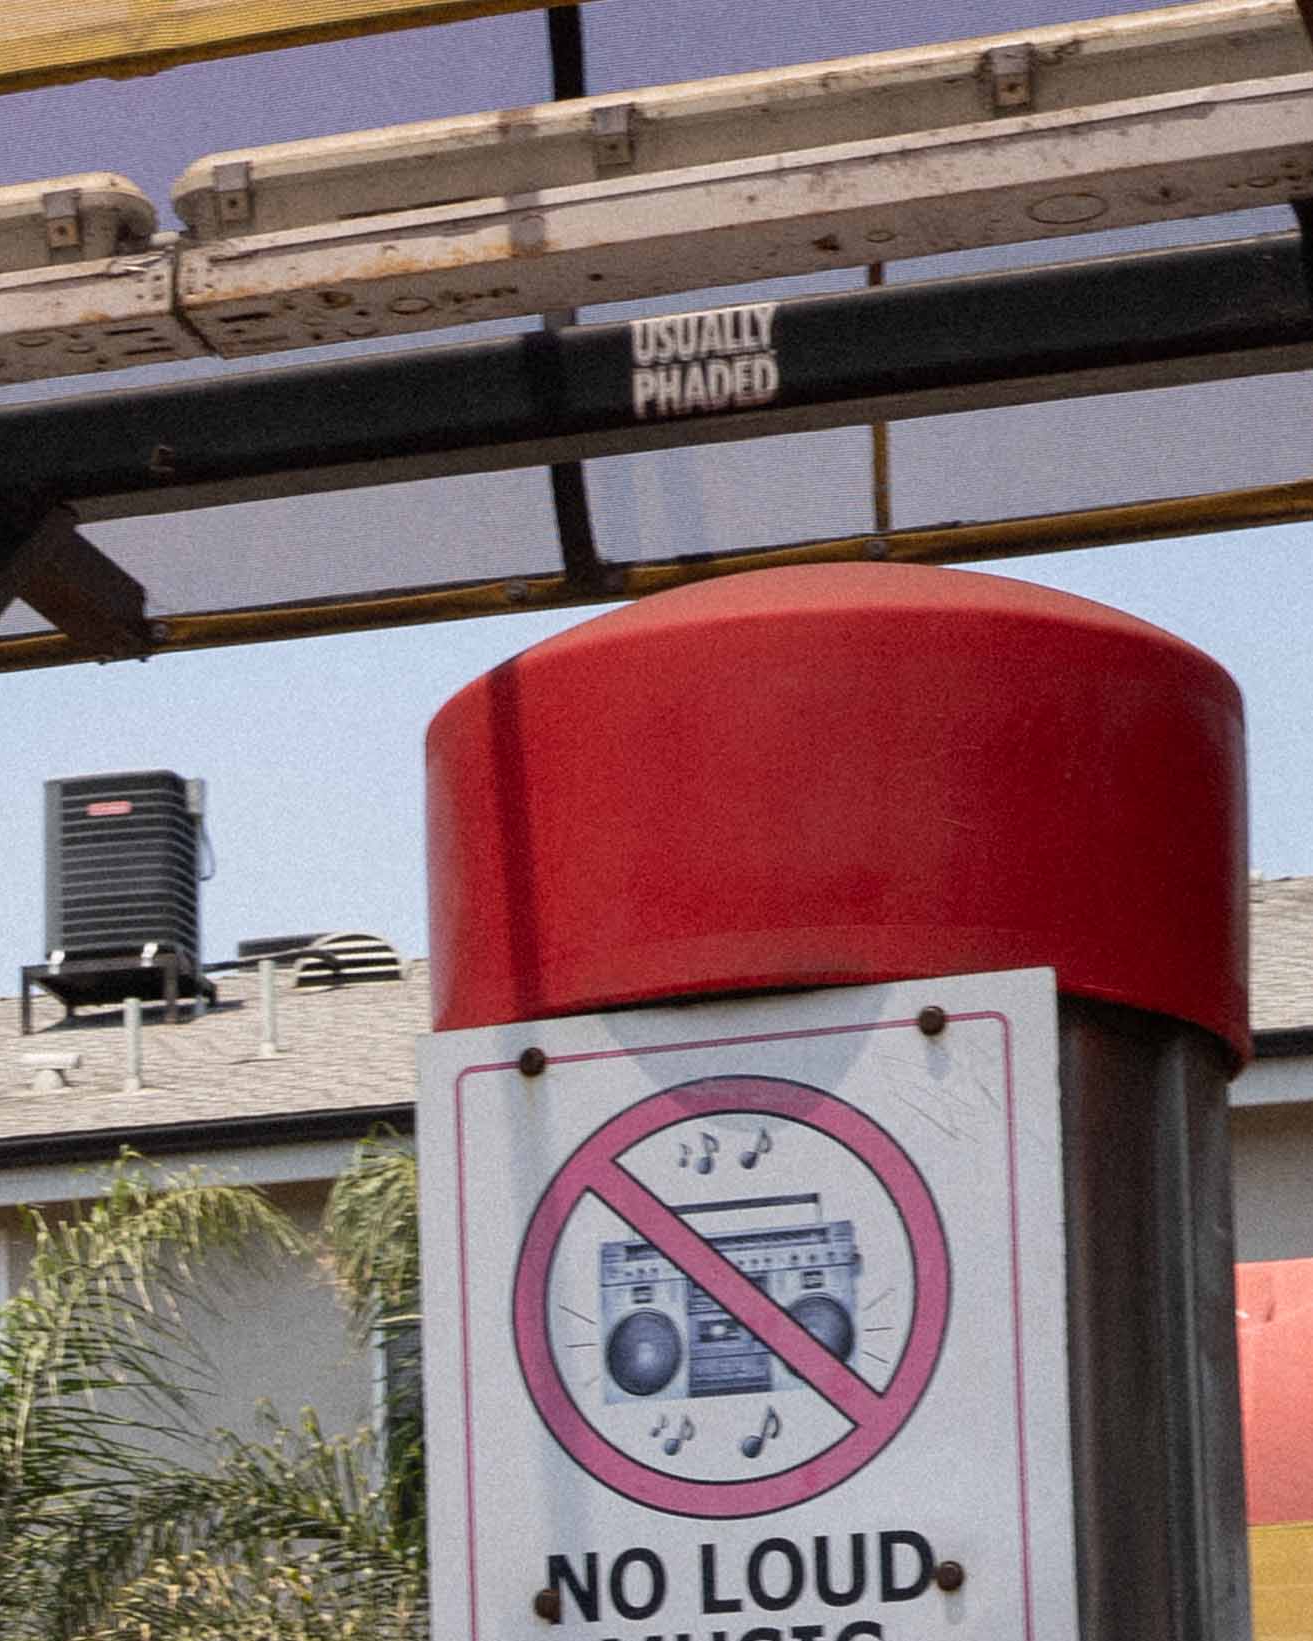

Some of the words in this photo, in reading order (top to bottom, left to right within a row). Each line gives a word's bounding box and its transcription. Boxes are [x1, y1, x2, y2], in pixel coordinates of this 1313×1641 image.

[630, 302, 776, 367] USUALLY
[632, 350, 779, 419] PHADED
[546, 1546, 668, 1625] NO
[699, 1529, 936, 1615] LOUD
